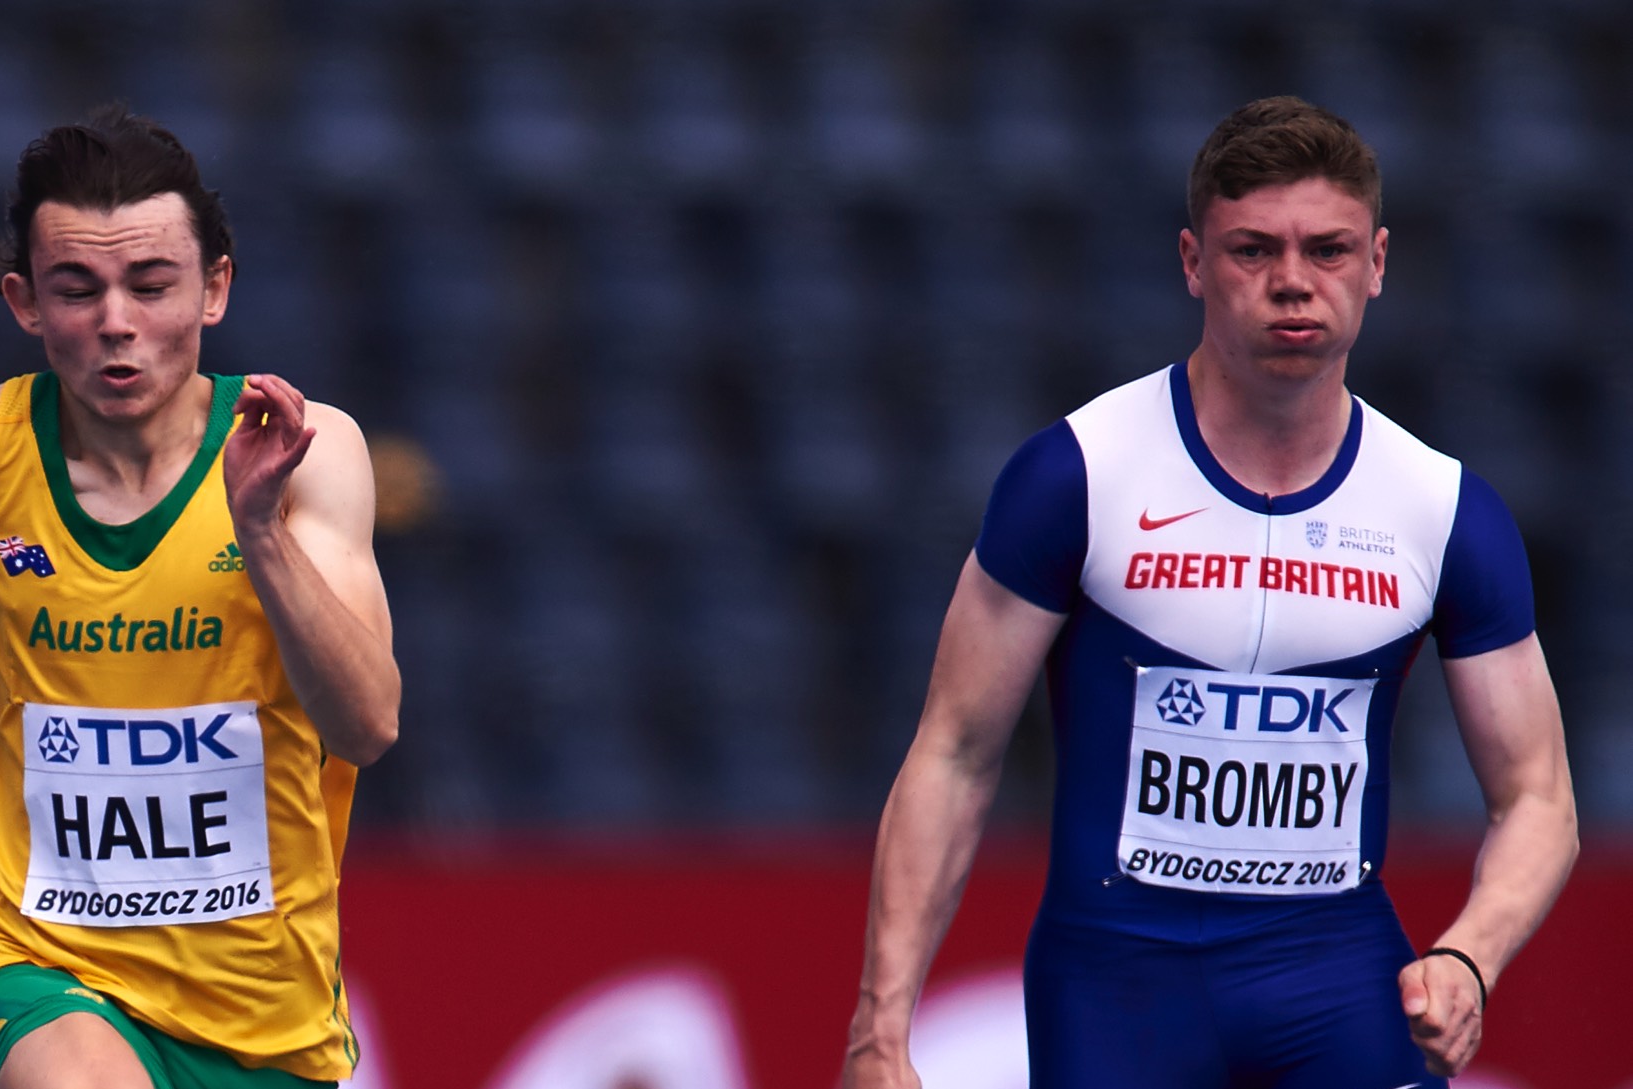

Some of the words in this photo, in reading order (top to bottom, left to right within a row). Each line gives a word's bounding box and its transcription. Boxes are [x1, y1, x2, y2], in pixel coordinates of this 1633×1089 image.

[1338, 540, 1396, 555] ATHLETICS
[1339, 526, 1395, 544] BRITISH
[1123, 552, 1251, 590] GREAT
[1259, 556, 1400, 609] BRITAIN
[28, 606, 223, 652] Australia
[1207, 683, 1356, 733] TDK
[78, 713, 239, 766] TDK
[1137, 749, 1359, 829] BROMBY
[51, 790, 232, 861] HALE
[1126, 848, 1294, 886] BYDGOSZCZ
[1294, 861, 1347, 885] 2016
[35, 888, 200, 917] BYDGOSZCZ
[203, 880, 261, 913] 2016
